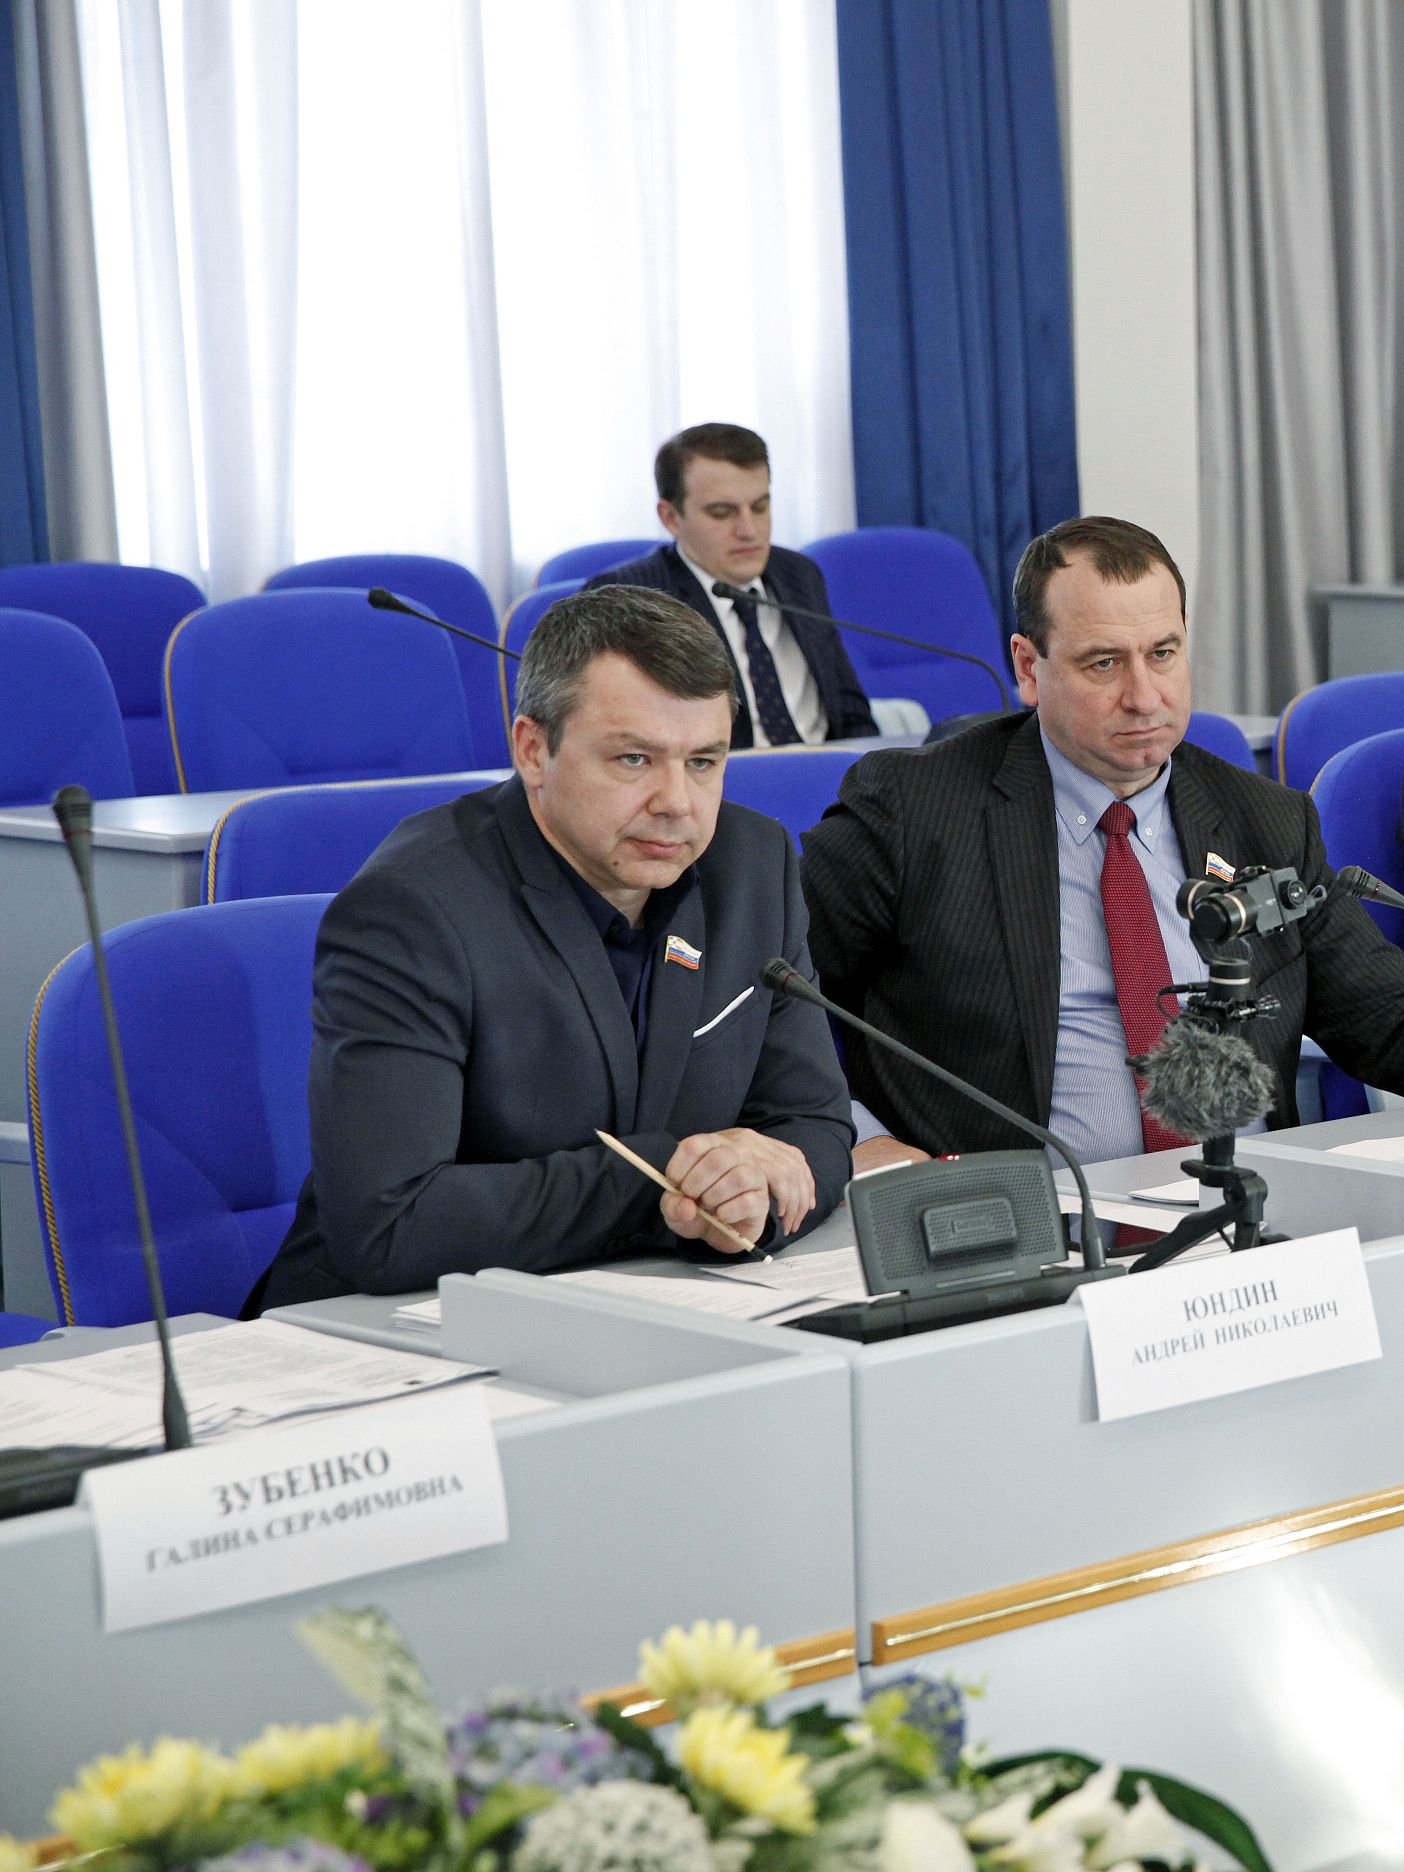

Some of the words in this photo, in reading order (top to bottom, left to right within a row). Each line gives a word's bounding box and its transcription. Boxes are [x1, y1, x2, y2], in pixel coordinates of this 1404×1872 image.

[1132, 1329, 1205, 1365] АНДРЕЙ
[1214, 1300, 1339, 1345] НИКОЛАЕВИЧ
[1183, 1279, 1279, 1322] ЮНДИН
[212, 1446, 391, 1518] ЗУБЕНКО
[145, 1525, 259, 1573] ГАЛИНА
[264, 1474, 464, 1540] СЕРАФИМОВНА
